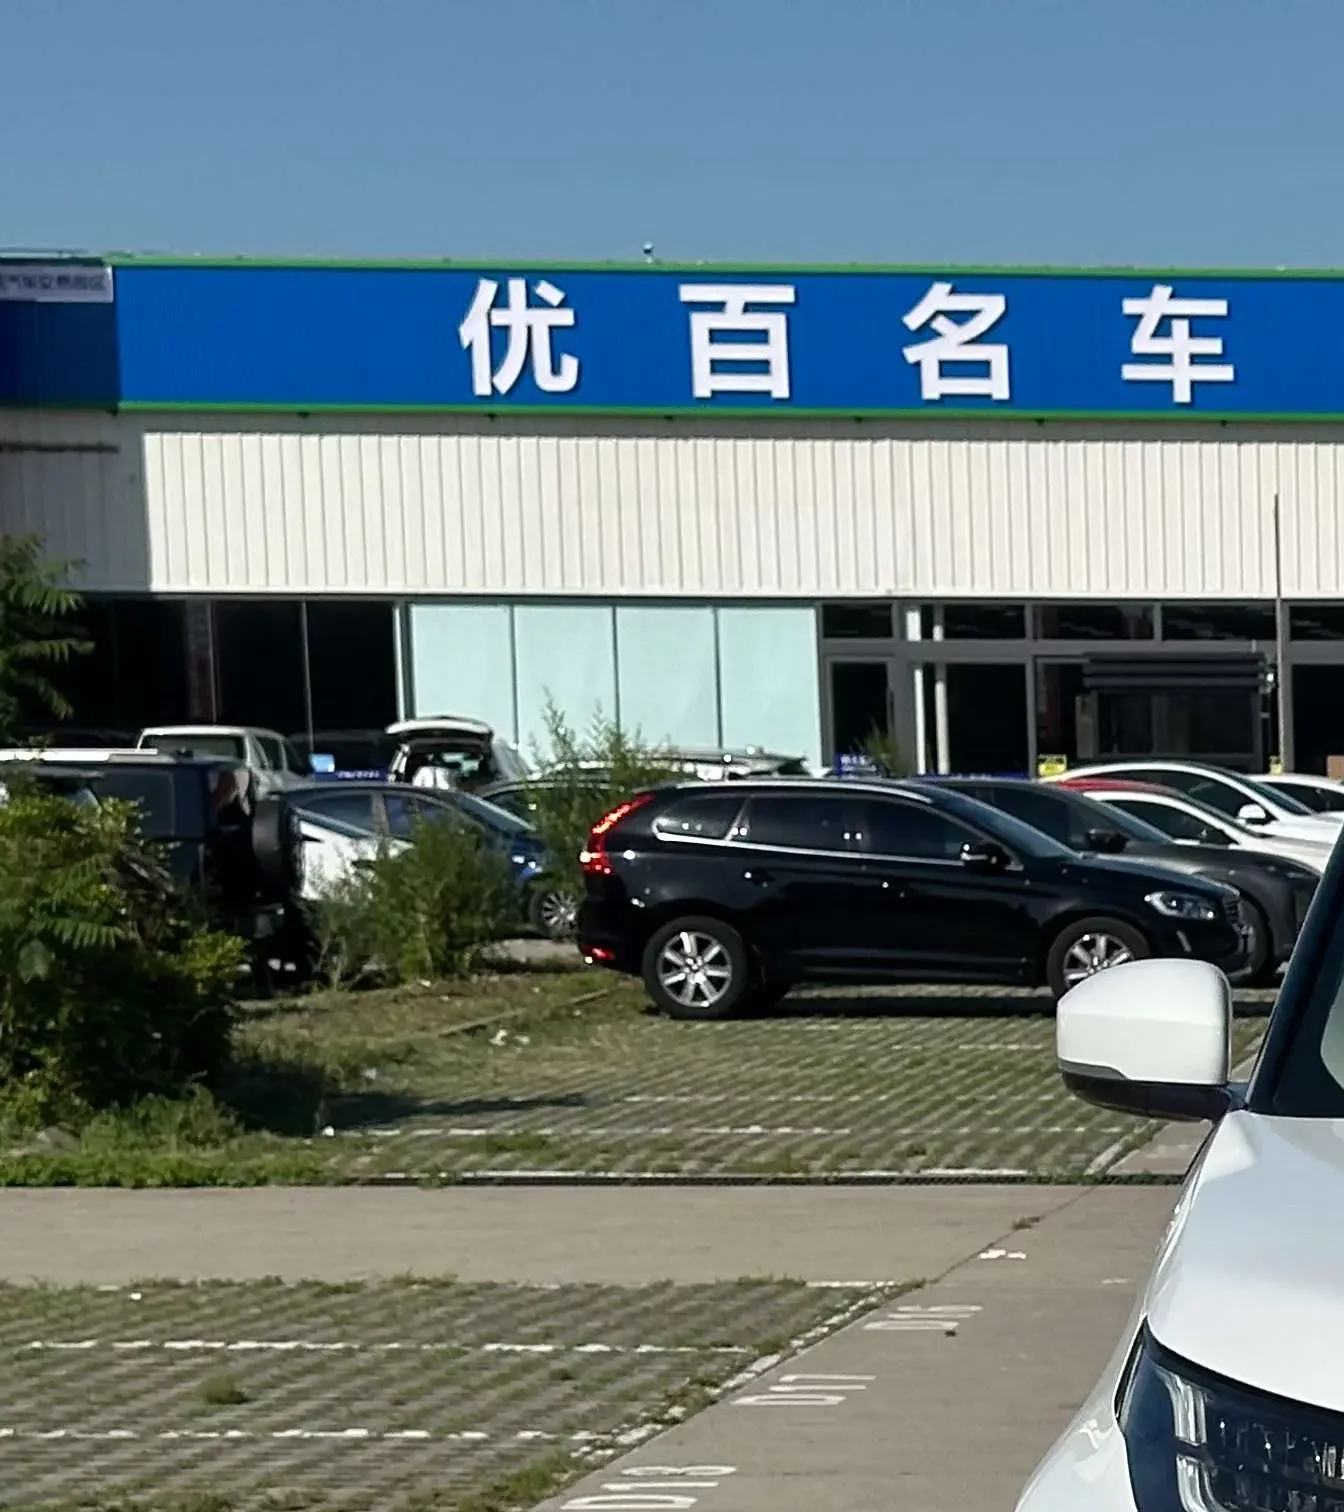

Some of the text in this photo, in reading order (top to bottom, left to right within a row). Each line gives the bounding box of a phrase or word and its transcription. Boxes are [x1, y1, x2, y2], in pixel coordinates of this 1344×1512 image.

[459, 279, 1234, 402] 优百名车
[731, 1374, 876, 1406] D17
[559, 1465, 737, 1510] D18
